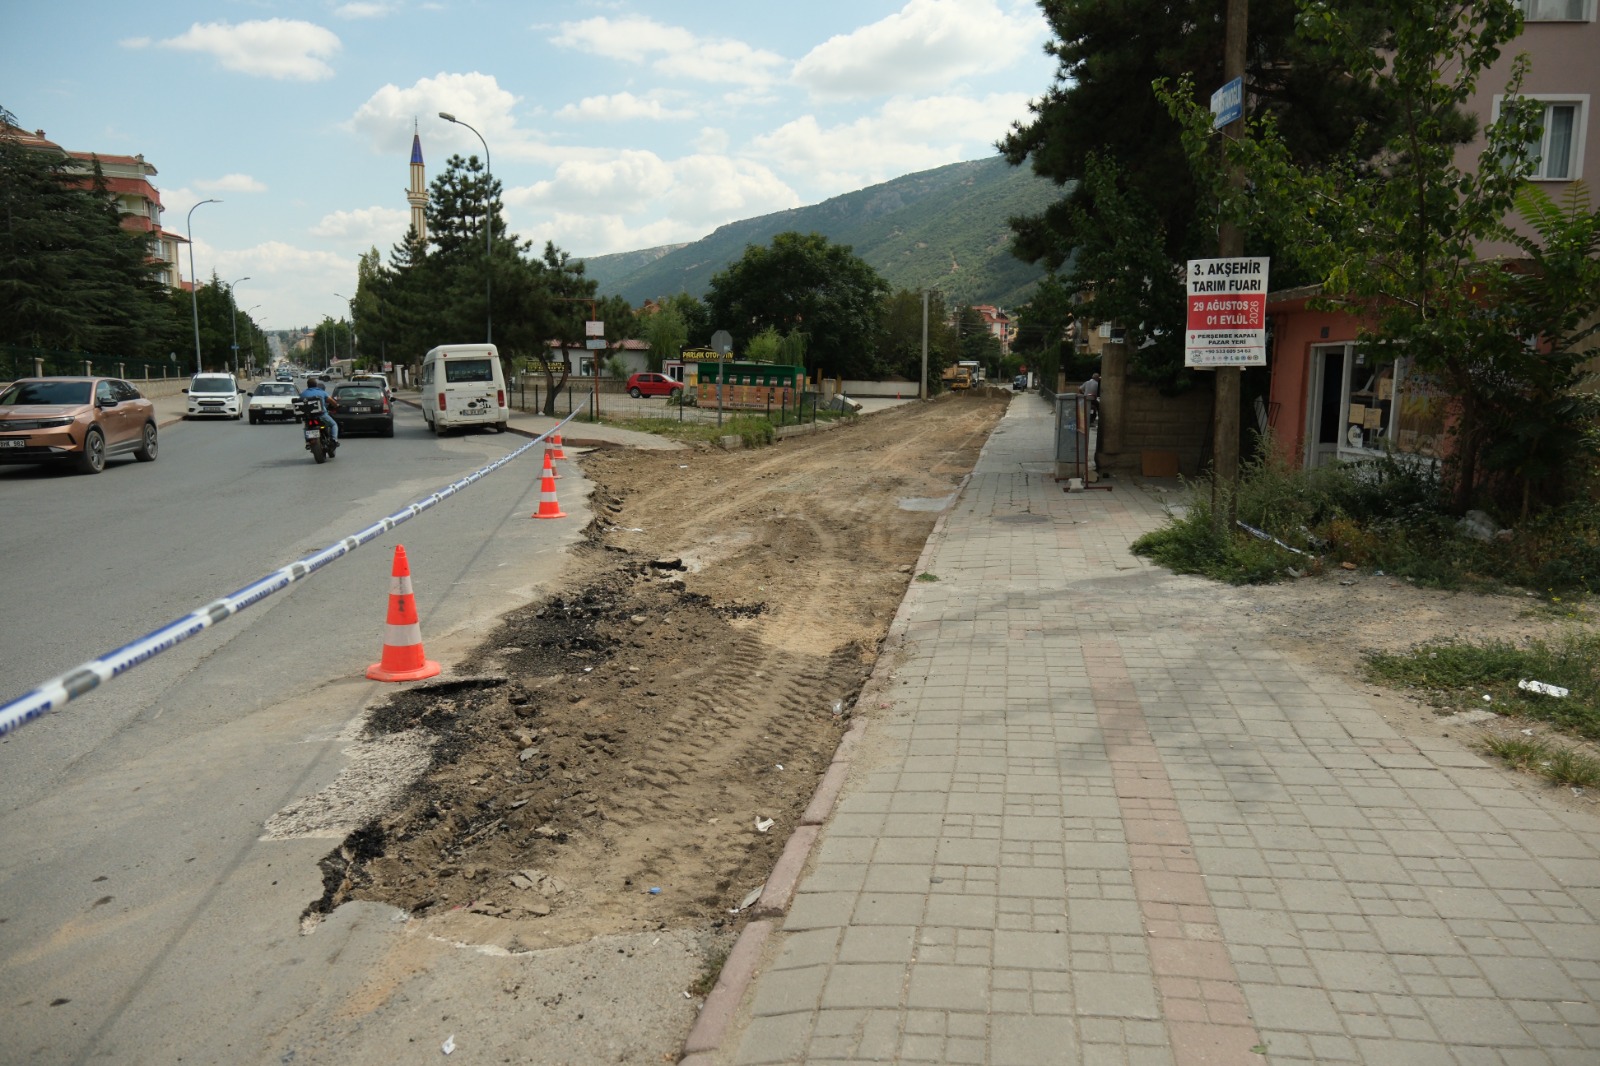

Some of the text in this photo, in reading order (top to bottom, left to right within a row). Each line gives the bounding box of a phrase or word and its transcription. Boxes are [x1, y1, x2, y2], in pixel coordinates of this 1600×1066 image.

[1194, 259, 1261, 277] 3. AKŞEHİR
[1193, 279, 1261, 292] TARIM FUARI
[1193, 299, 1249, 312] 29 AĞUSTOS
[1207, 313, 1248, 325] 01 EYLÜL
